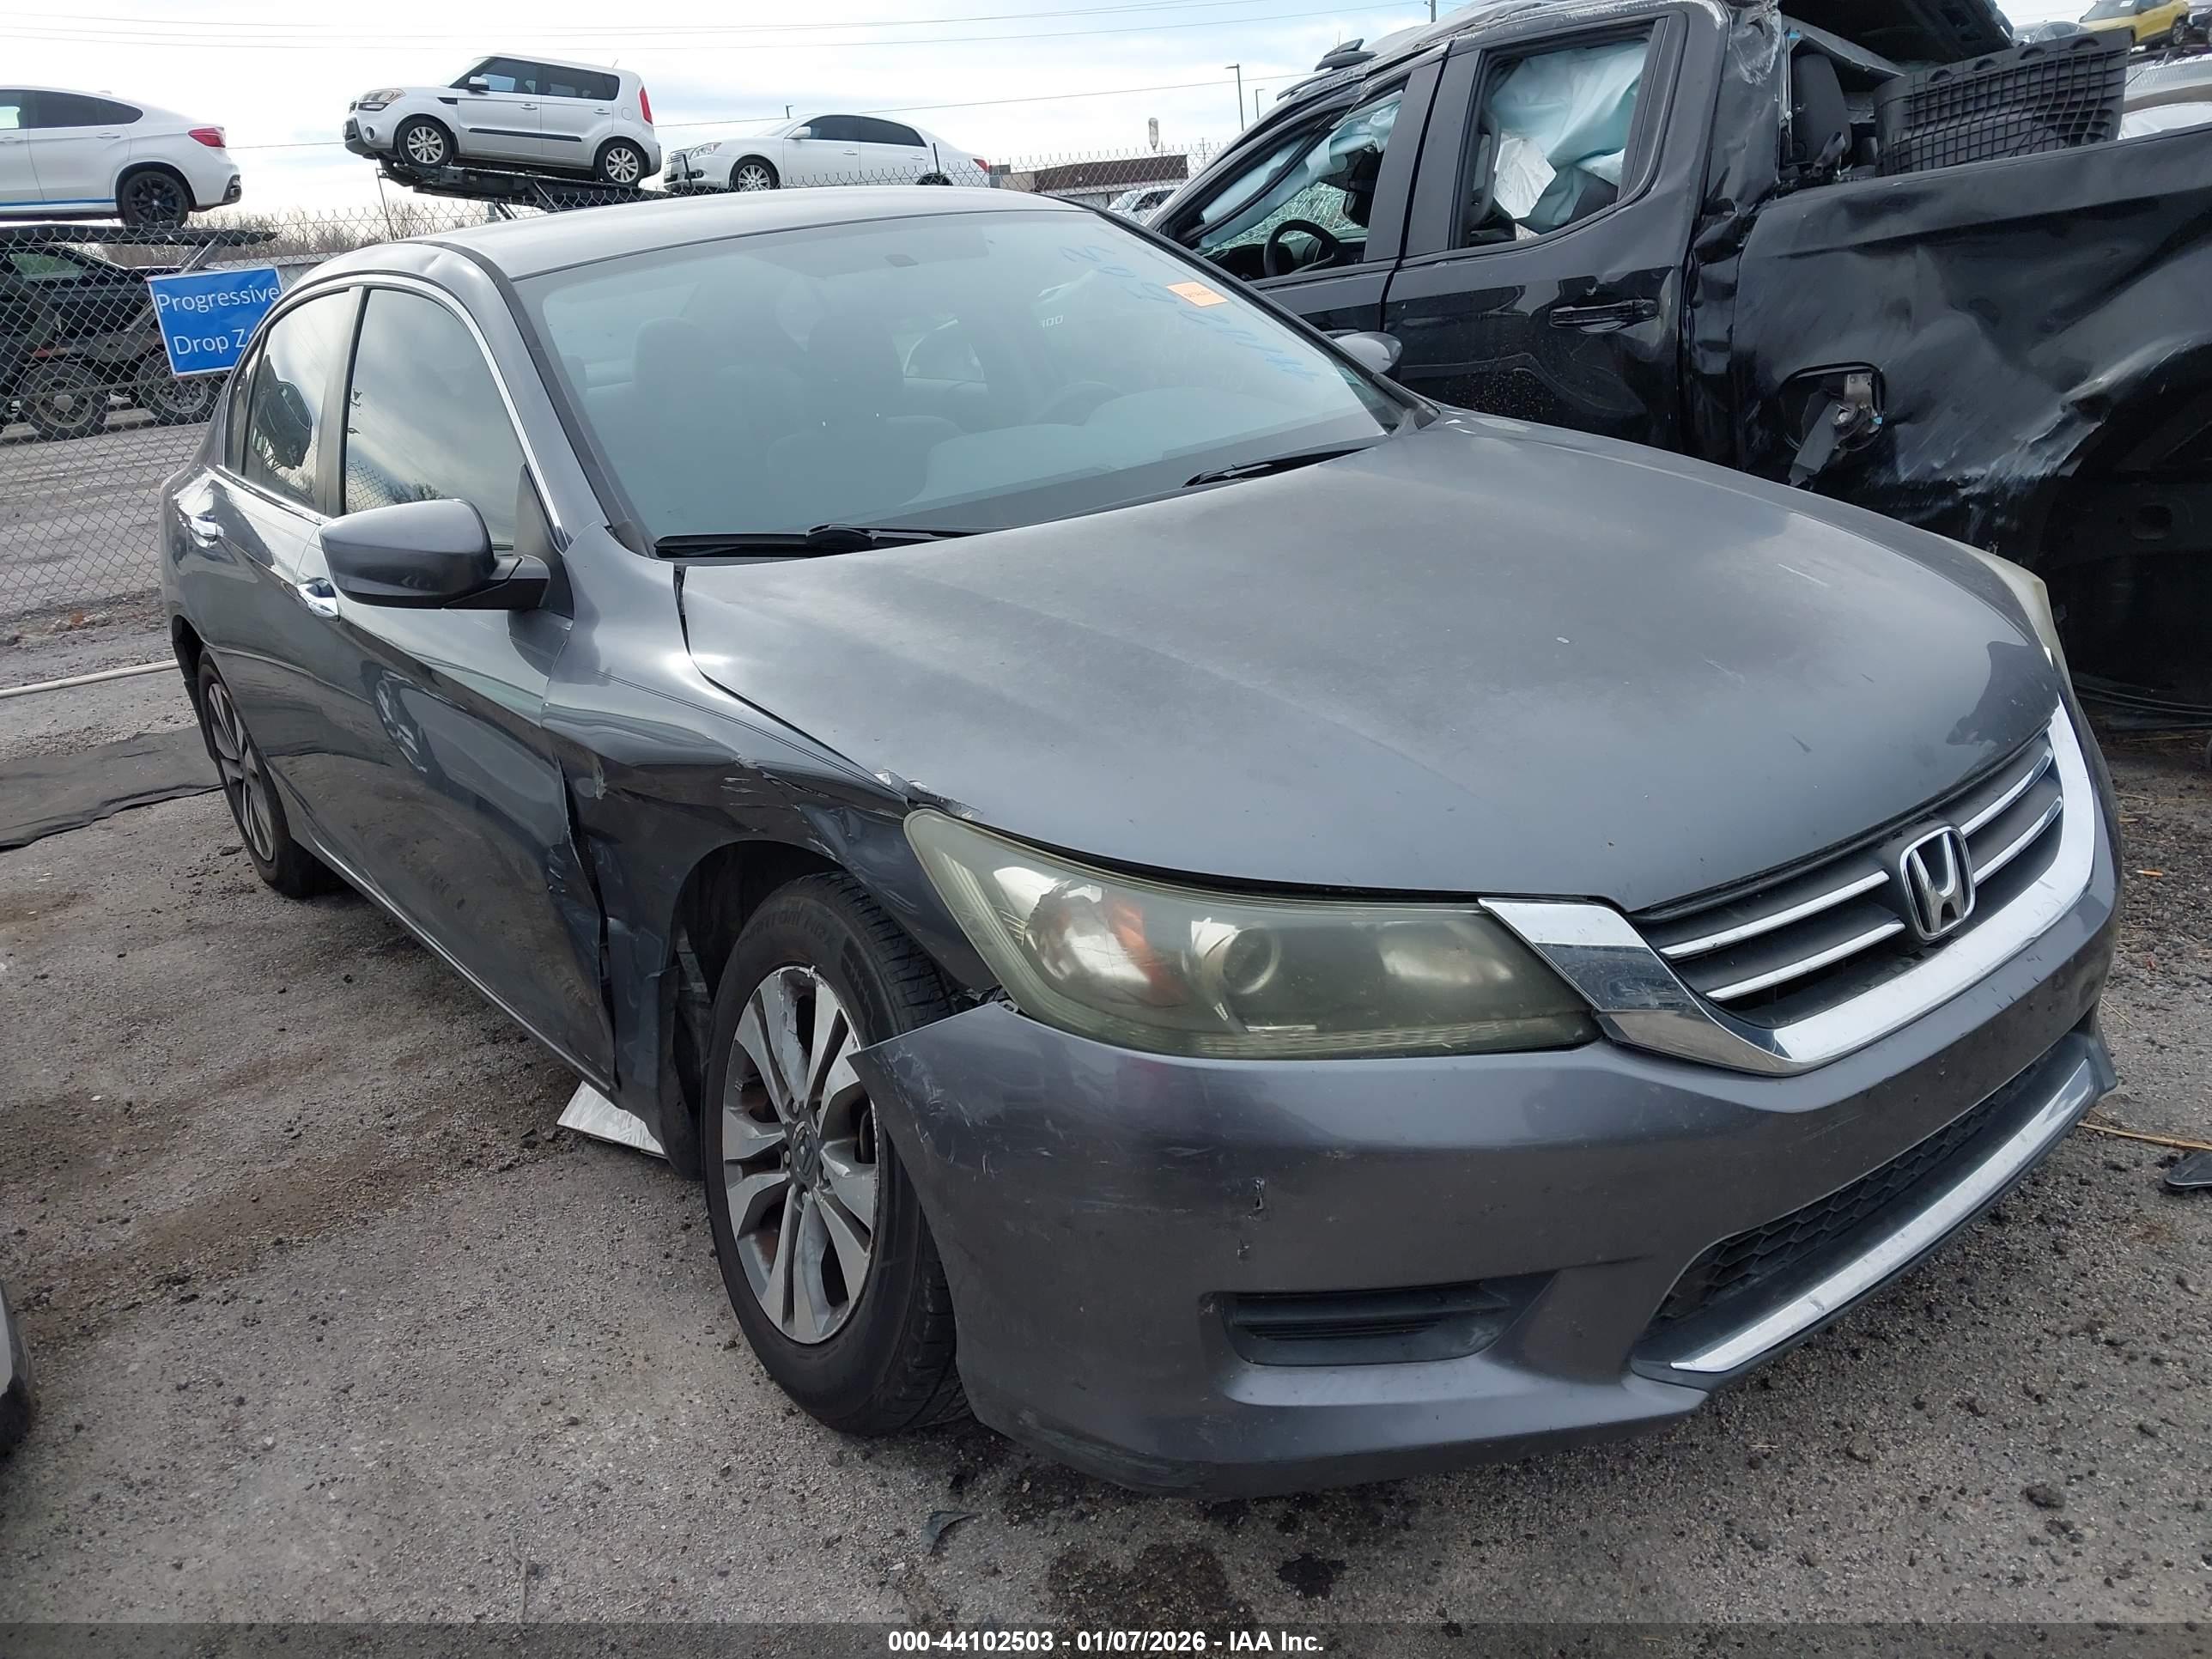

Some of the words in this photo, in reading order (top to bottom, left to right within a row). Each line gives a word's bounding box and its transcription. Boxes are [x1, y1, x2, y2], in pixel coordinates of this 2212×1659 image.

[155, 284, 279, 313] Progressive
[173, 335, 229, 355] Drop
[231, 328, 253, 349] Z
